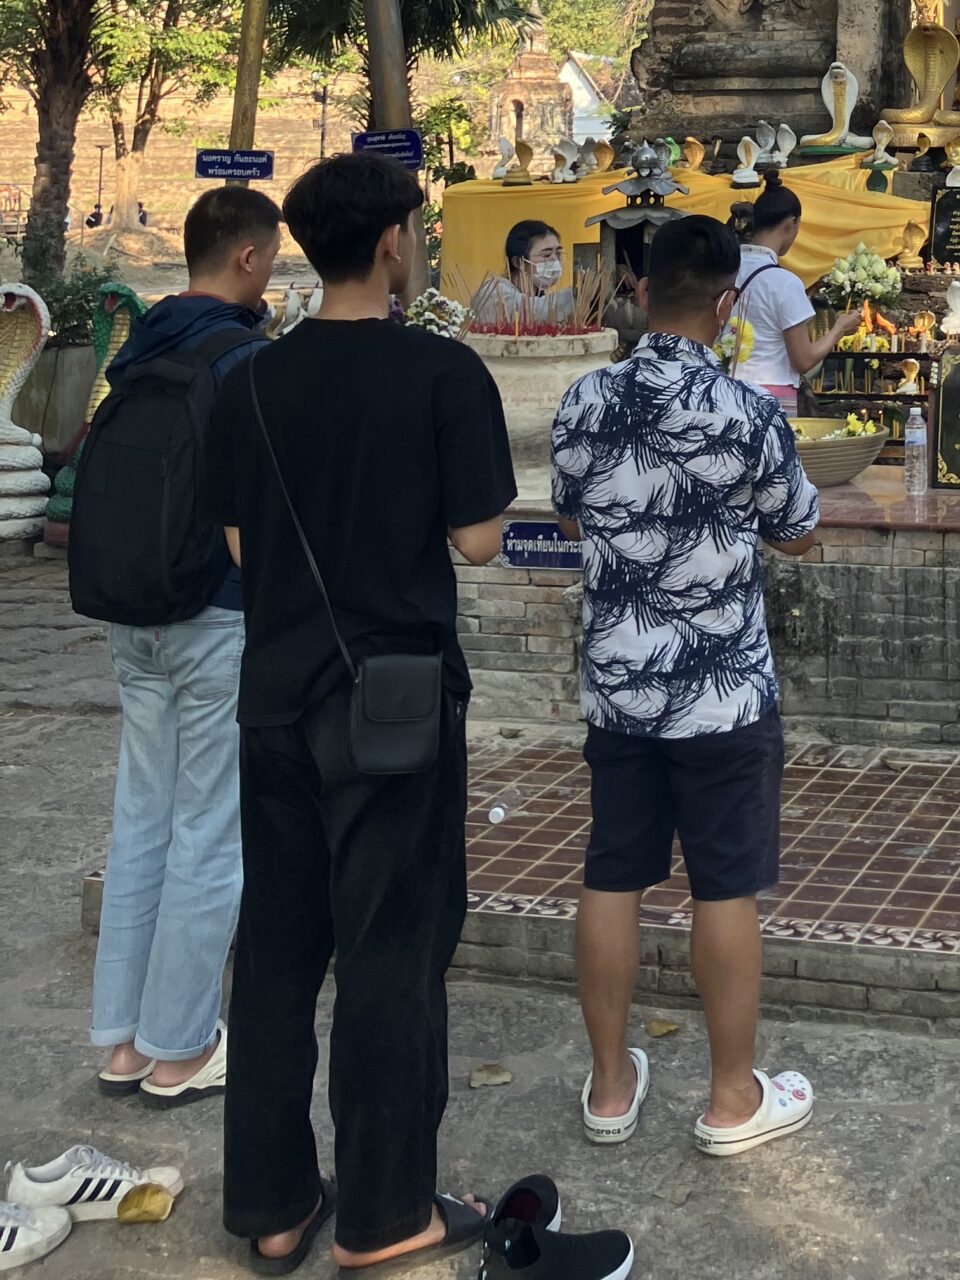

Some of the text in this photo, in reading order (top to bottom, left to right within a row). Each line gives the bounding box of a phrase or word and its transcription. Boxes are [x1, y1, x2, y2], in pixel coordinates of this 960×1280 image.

[207, 165, 262, 177] พร้อมครอบครัว
